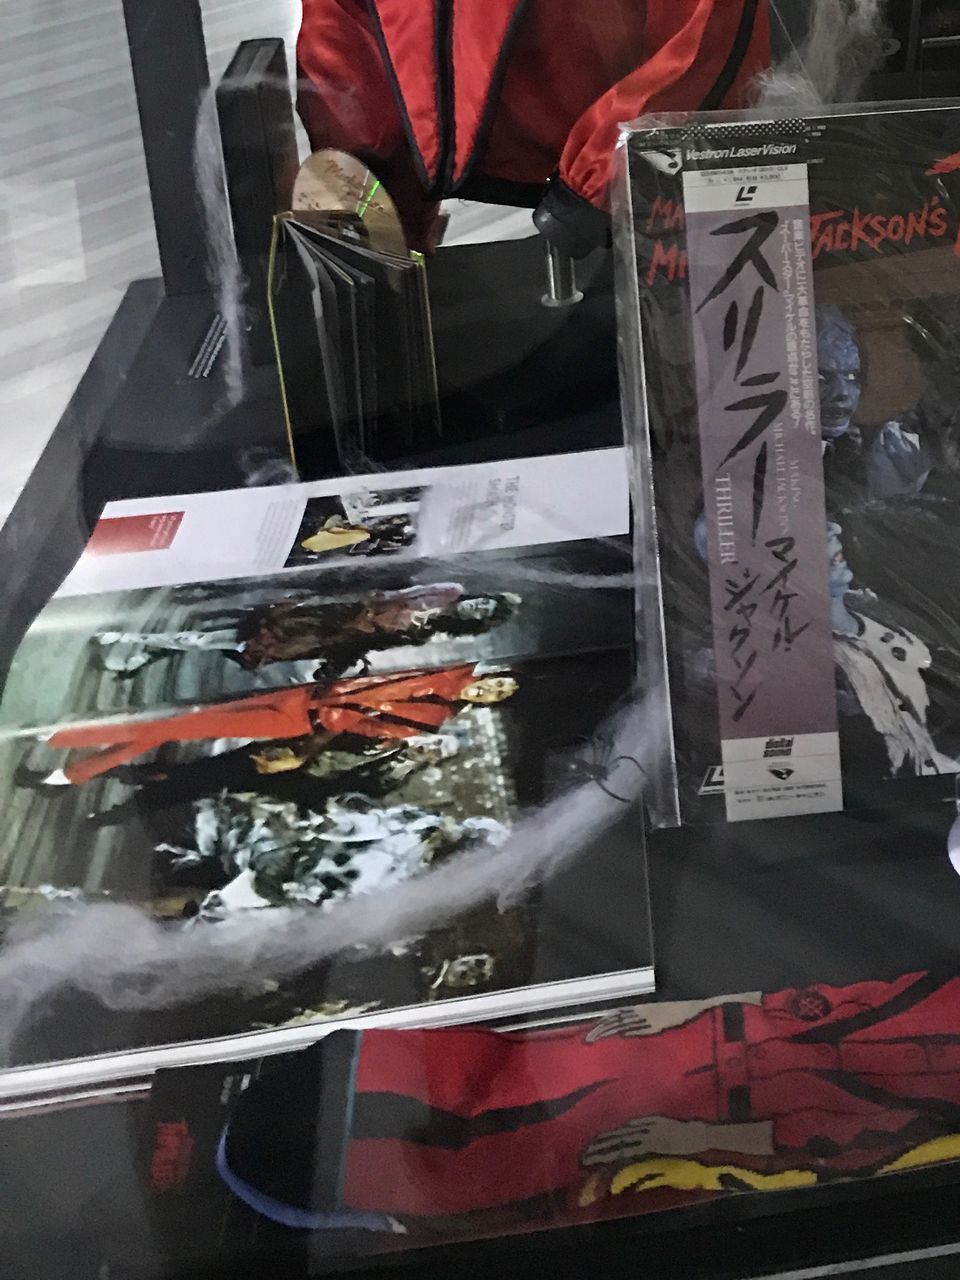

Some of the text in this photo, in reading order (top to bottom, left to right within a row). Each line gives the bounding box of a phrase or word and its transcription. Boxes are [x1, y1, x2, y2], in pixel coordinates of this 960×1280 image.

[685, 143, 797, 162] Vestron LaserVision
[809, 195, 948, 260] JACKSON'S
[694, 210, 789, 547] スリラー
[714, 472, 738, 564] THRILLER
